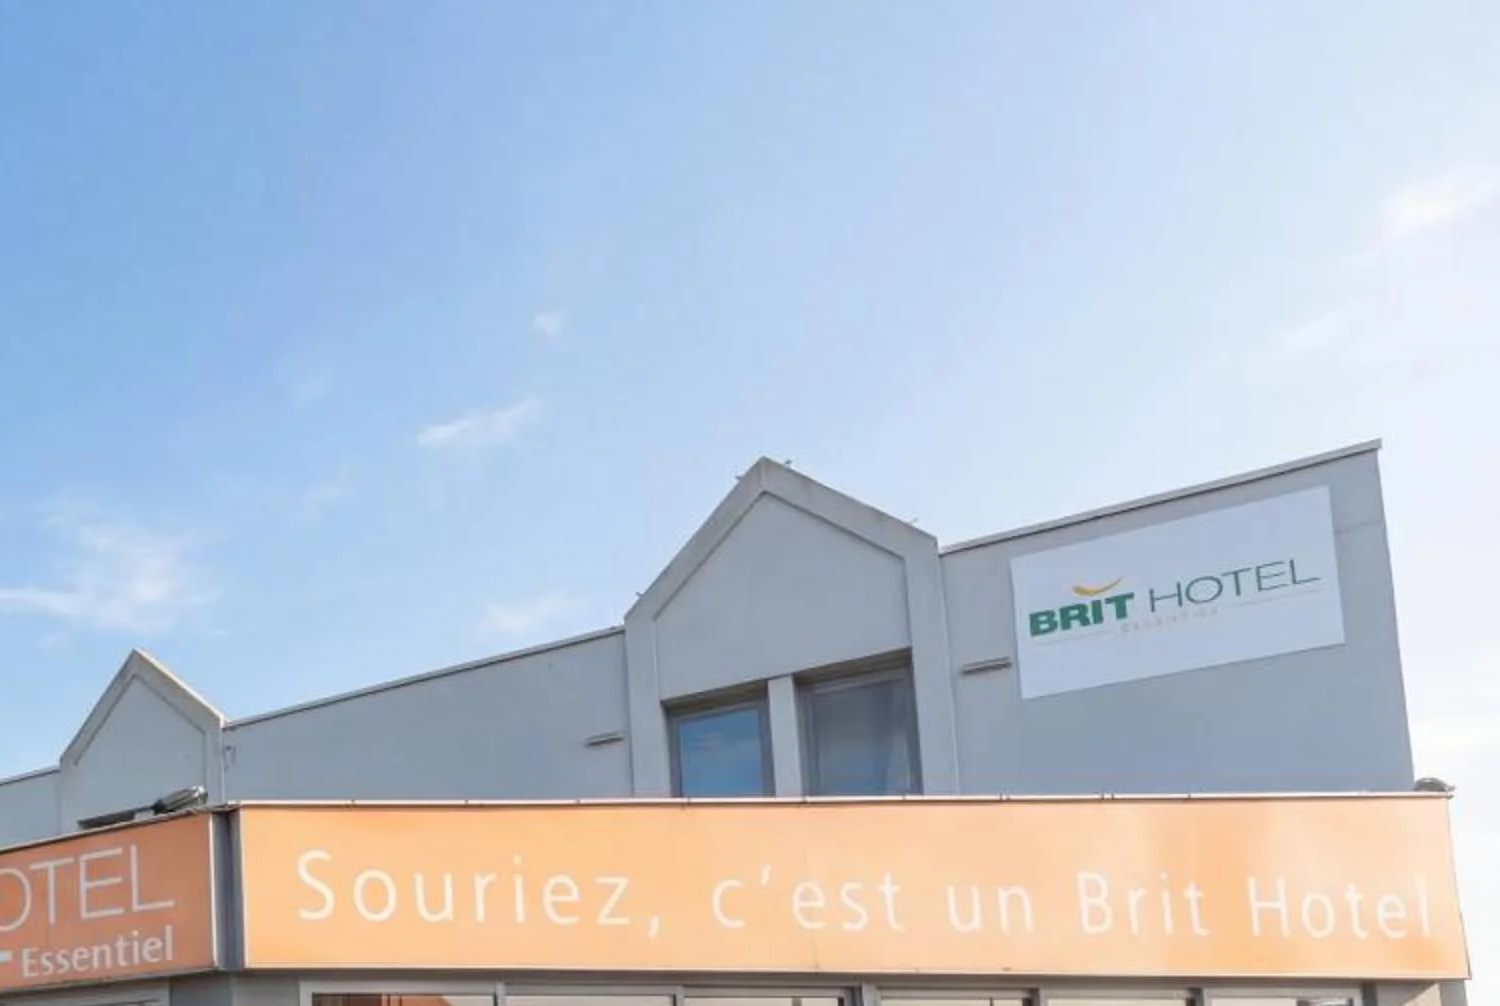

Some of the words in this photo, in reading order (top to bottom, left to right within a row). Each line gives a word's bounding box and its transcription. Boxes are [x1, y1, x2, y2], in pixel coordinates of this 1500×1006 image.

[1028, 592, 1135, 637] BRIT
[1149, 559, 1321, 613] HOTEL
[297, 849, 661, 939] Souriez,
[712, 864, 904, 931] c'est
[946, 884, 1034, 932] un
[1076, 870, 1210, 936] Brit
[1246, 874, 1432, 940] Hotel
[21, 927, 174, 978] Essentiel
